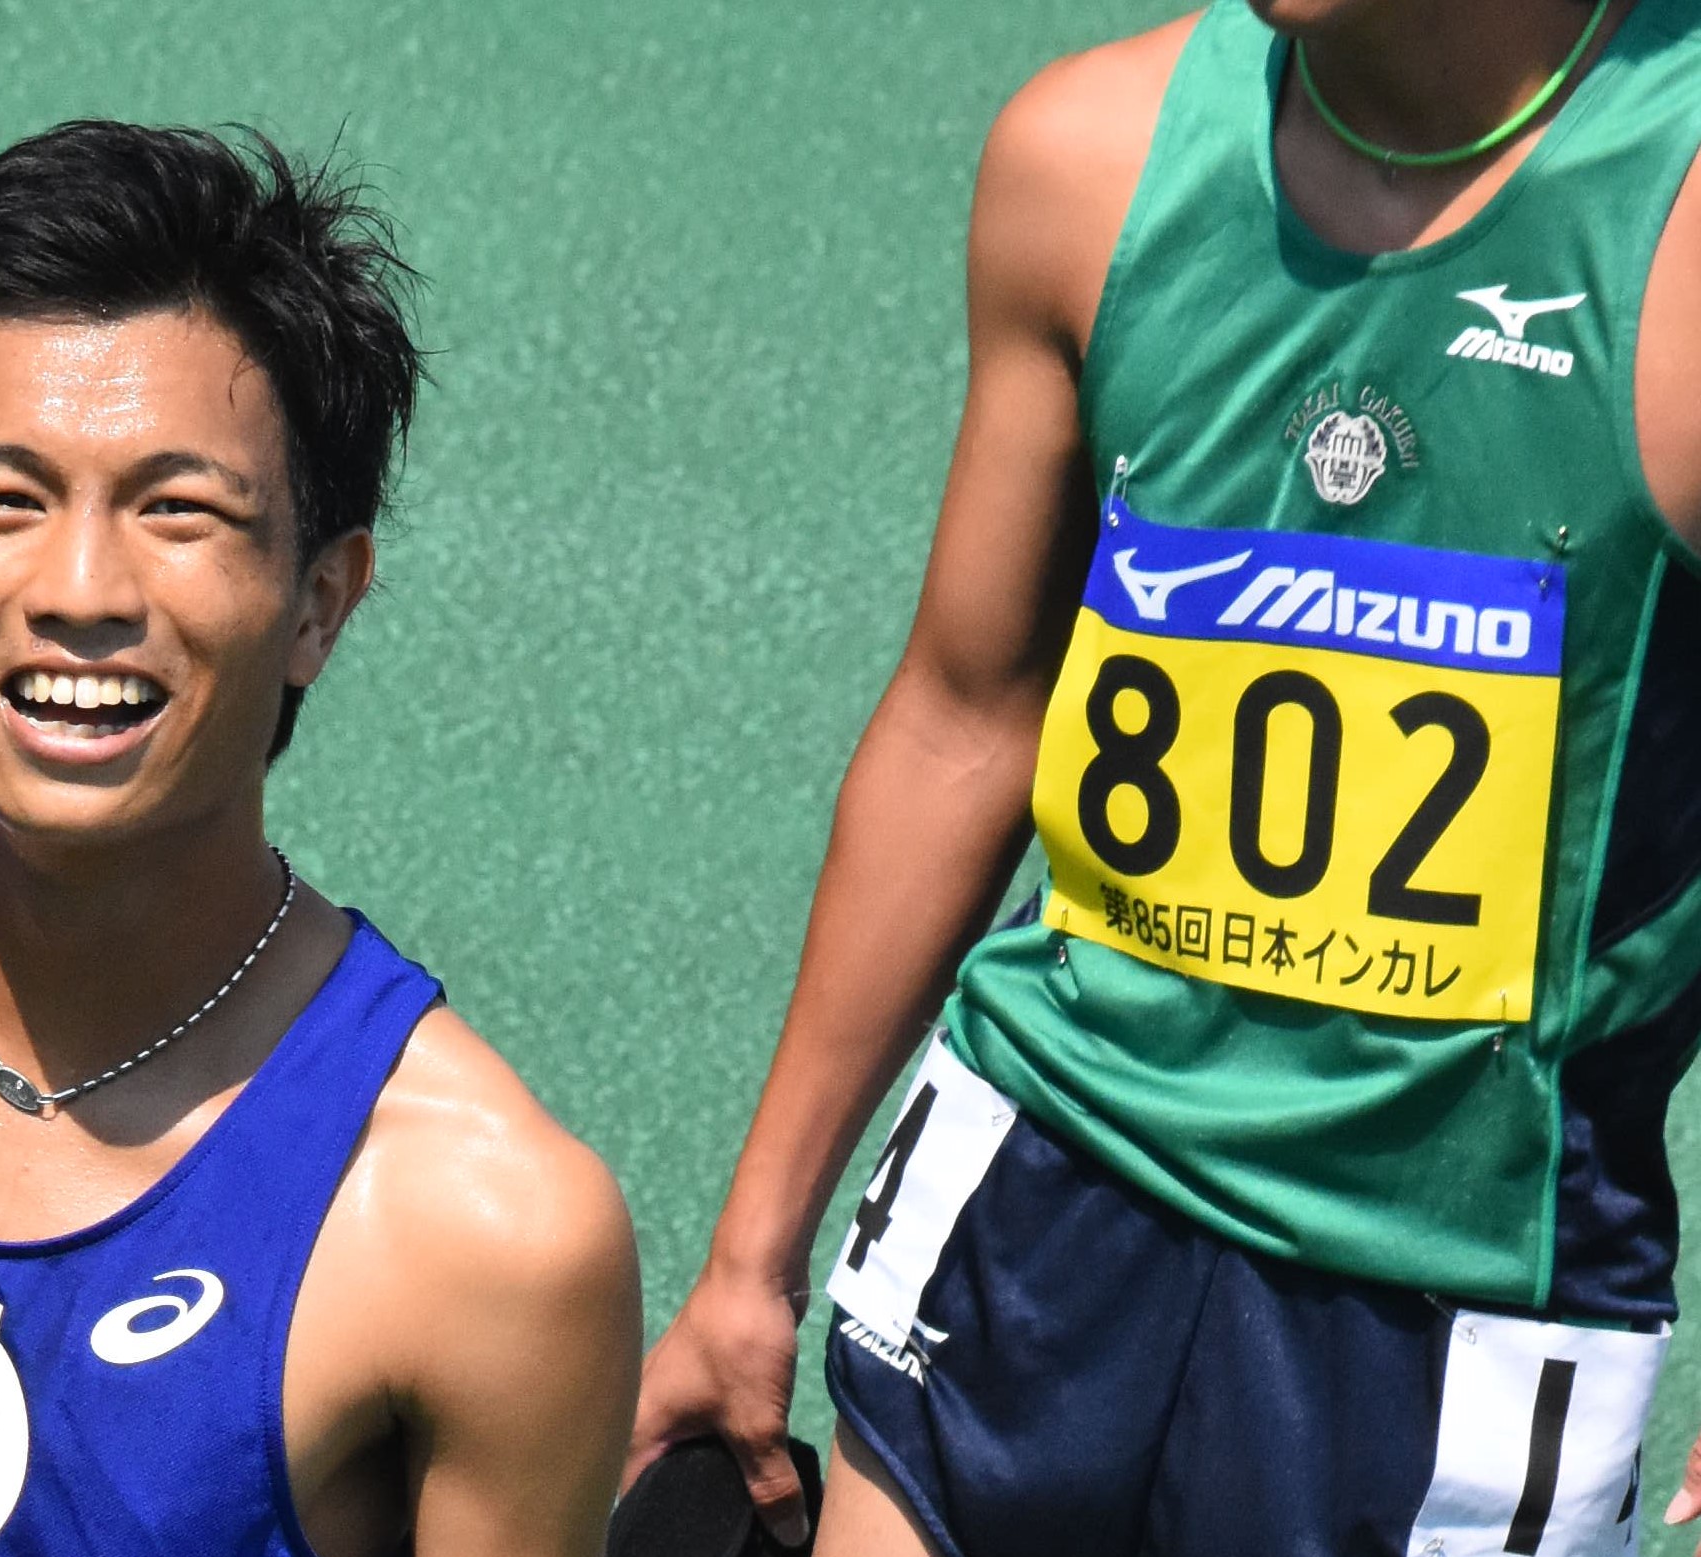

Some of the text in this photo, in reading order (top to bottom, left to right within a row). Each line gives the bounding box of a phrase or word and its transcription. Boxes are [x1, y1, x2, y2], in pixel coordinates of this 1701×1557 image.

[1218, 566, 1531, 660] MIZUNO
[1077, 654, 1491, 927] 802
[1100, 882, 1462, 999] 第85回日本インカレ
